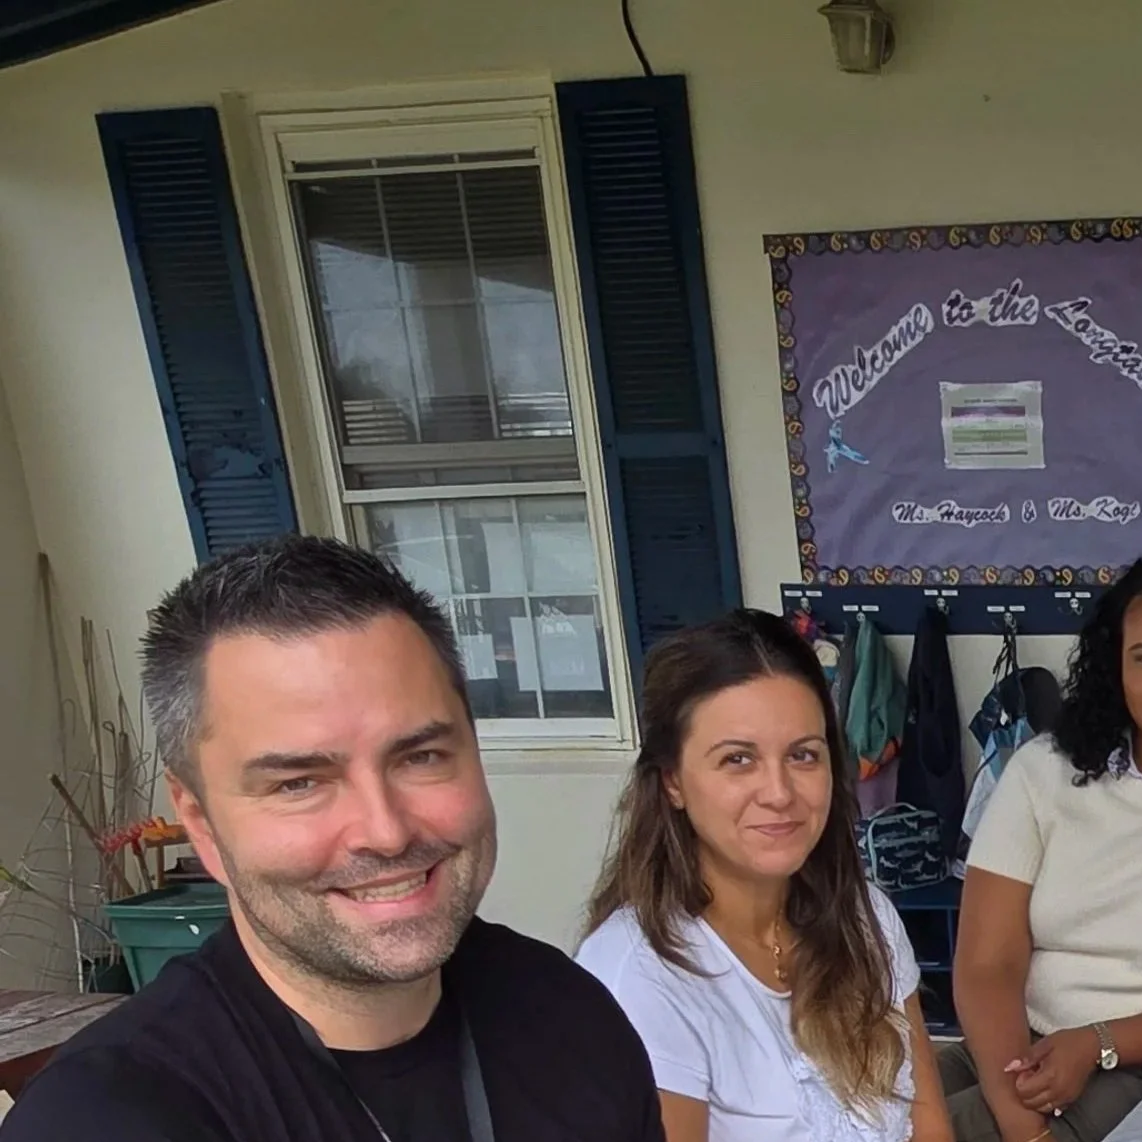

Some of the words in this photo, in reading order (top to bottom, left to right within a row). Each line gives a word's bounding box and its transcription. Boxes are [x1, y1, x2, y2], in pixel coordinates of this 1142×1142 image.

[815, 306, 929, 414] Welcome
[945, 293, 977, 325] to
[988, 282, 1039, 323] the
[895, 503, 930, 521] Ms.
[937, 502, 1007, 525] Haycock
[1022, 501, 1036, 520] &
[1050, 499, 1086, 519] Ms.
